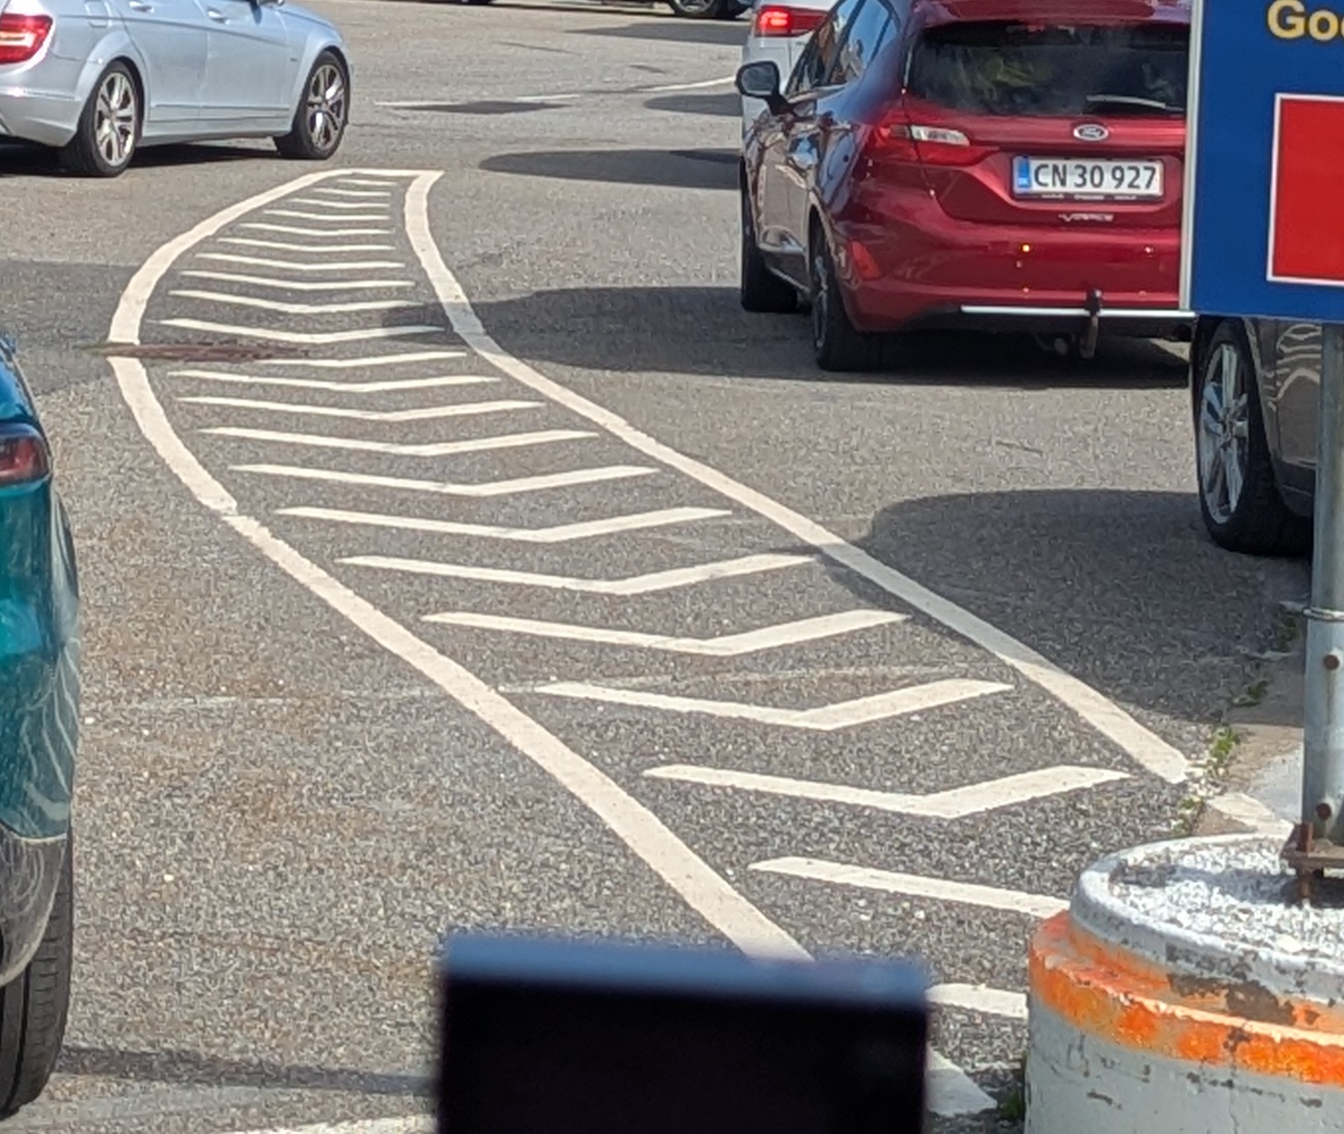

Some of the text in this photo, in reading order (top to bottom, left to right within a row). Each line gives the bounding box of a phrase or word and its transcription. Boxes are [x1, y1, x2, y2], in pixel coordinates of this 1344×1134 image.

[1034, 164, 1156, 189] CN 30 927
